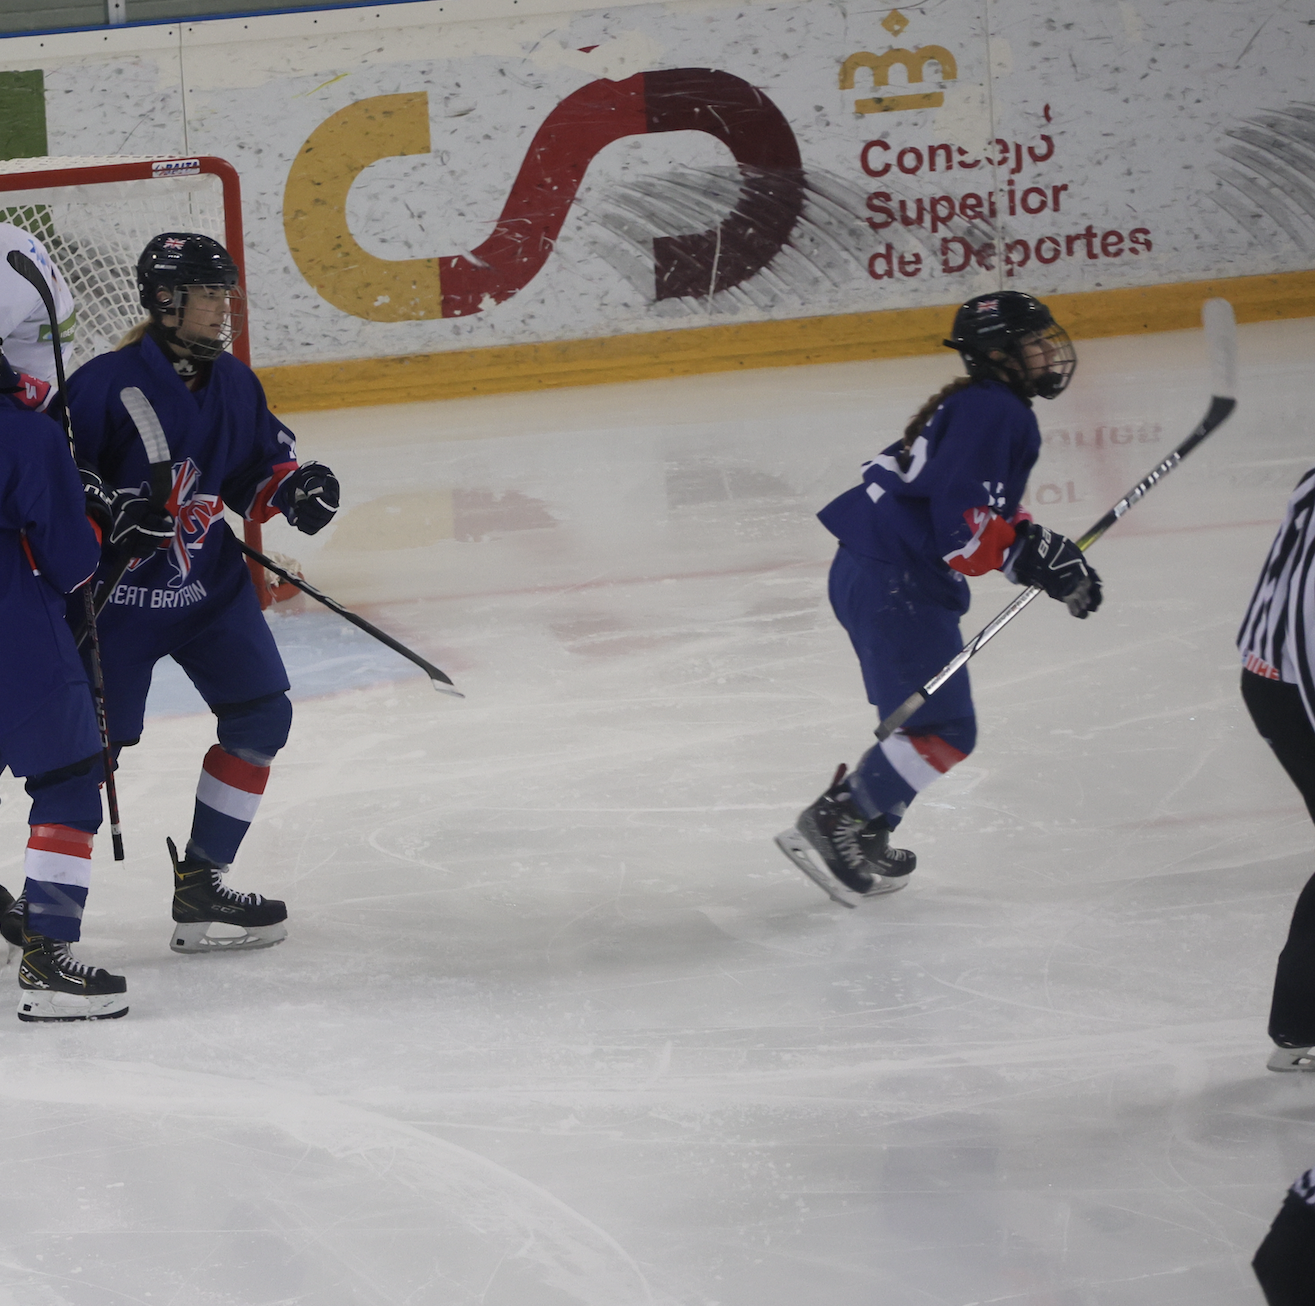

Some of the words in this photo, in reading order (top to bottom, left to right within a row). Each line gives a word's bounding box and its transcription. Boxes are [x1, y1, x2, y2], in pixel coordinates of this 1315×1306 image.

[866, 179, 1069, 233] Superior
[868, 243, 923, 280] de
[941, 225, 1152, 277] Deportes
[150, 579, 207, 608] BRITAIN
[94, 696, 109, 748] CCM
